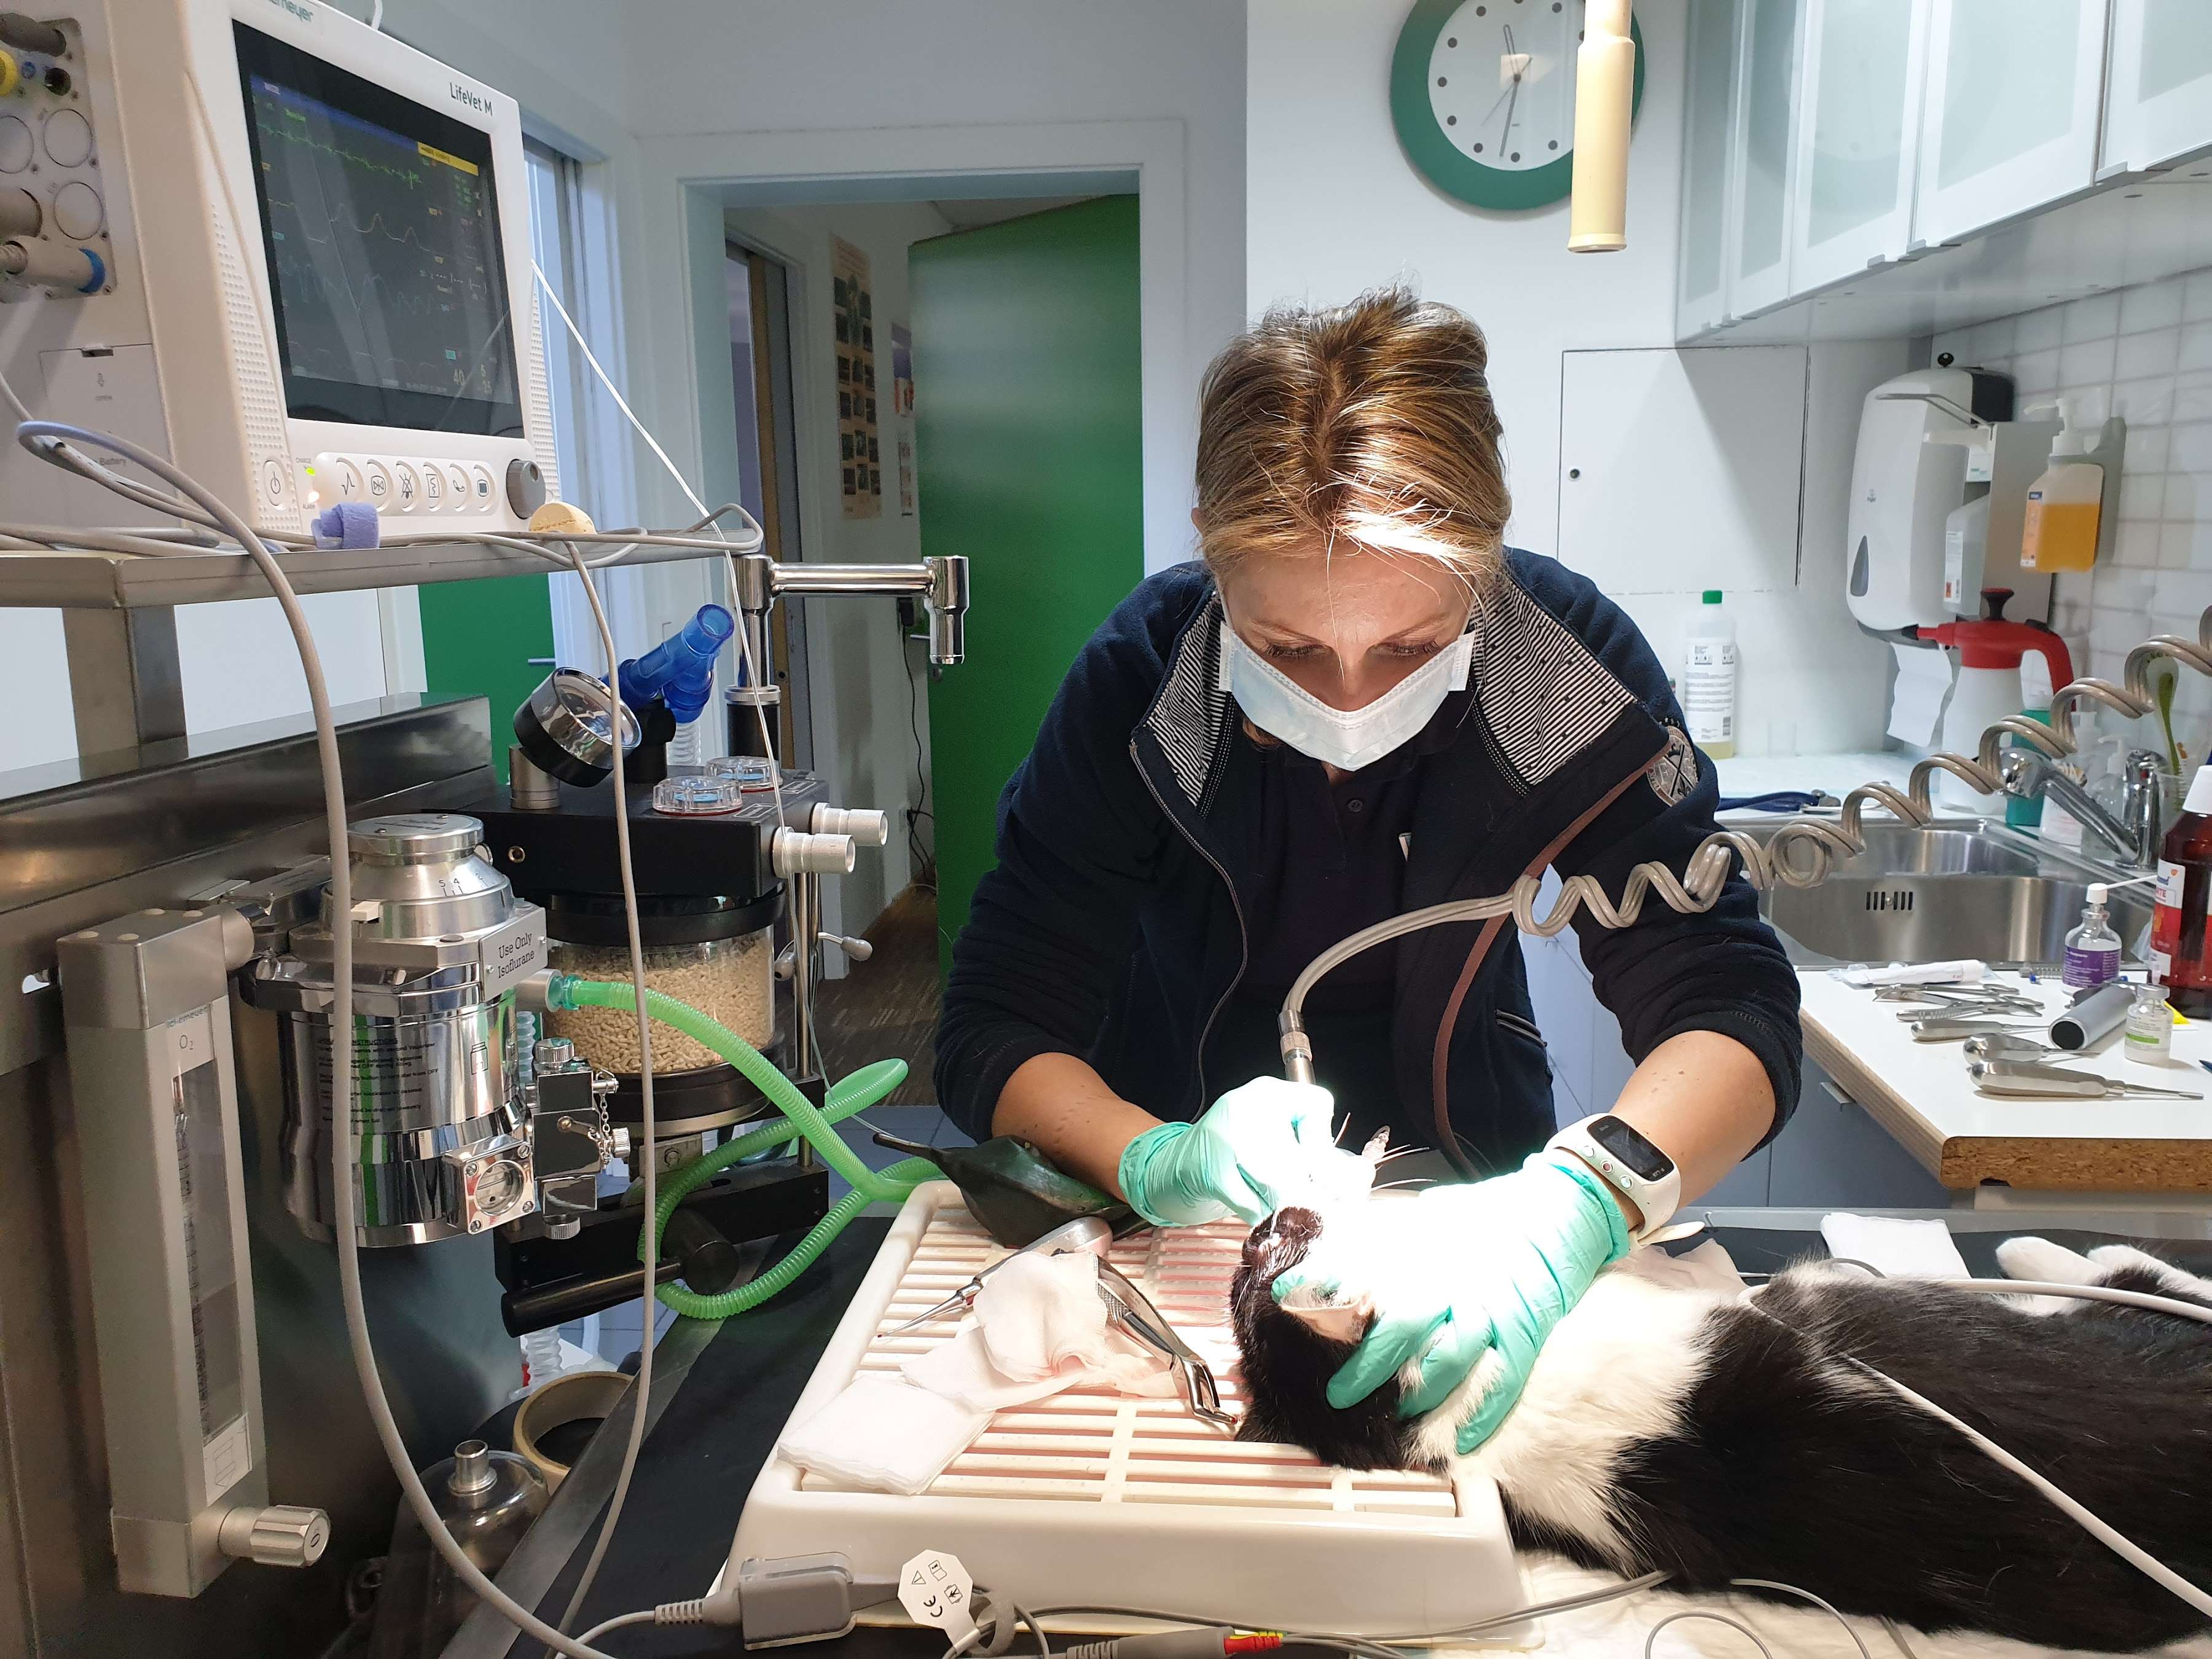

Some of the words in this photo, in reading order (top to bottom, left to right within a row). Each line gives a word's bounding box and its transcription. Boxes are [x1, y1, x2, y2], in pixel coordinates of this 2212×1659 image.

[450, 82, 482, 111] LifeVet
[484, 98, 493, 116] M
[498, 944, 514, 959] Use
[515, 932, 533, 950] Only
[498, 950, 535, 979] Isoflurane
